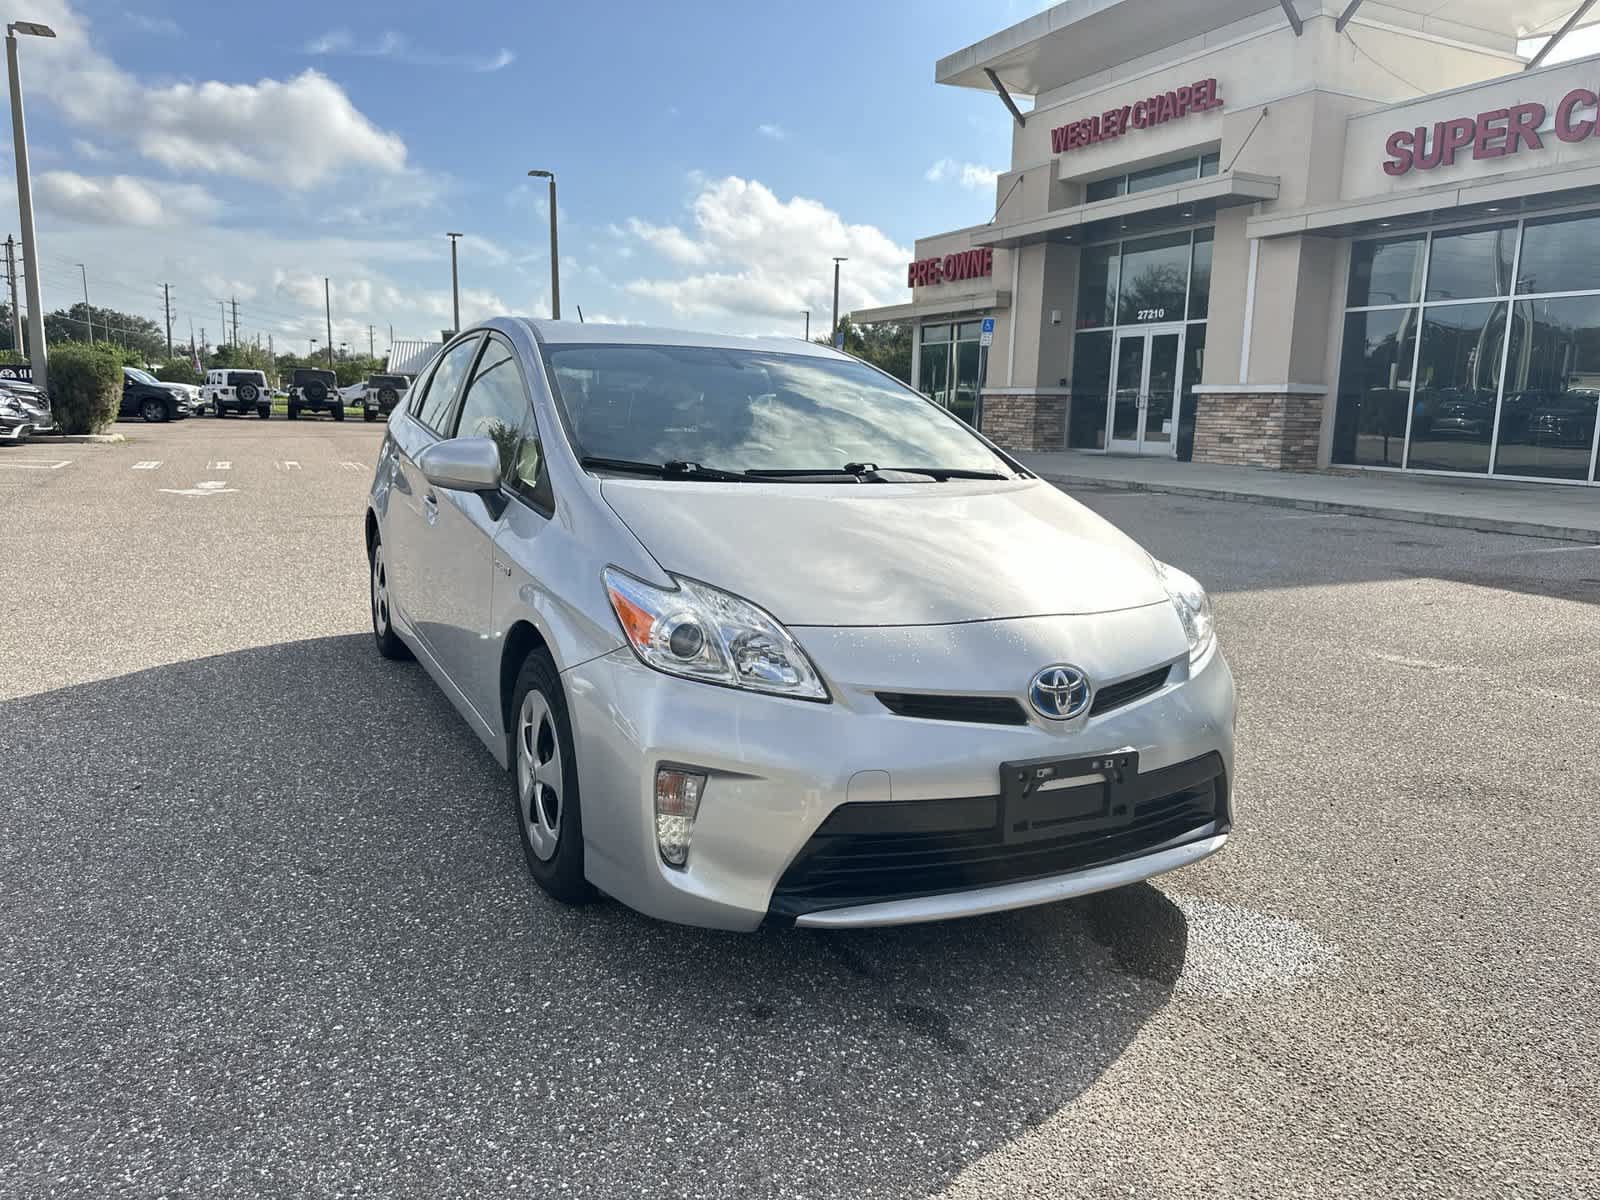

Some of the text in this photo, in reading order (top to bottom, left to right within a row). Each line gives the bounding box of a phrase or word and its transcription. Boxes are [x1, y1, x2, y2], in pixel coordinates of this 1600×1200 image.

[1050, 78, 1224, 154] WESLEY CHAPEL
[1382, 87, 1600, 176] SUPER C
[1137, 308, 1165, 320] 27210
